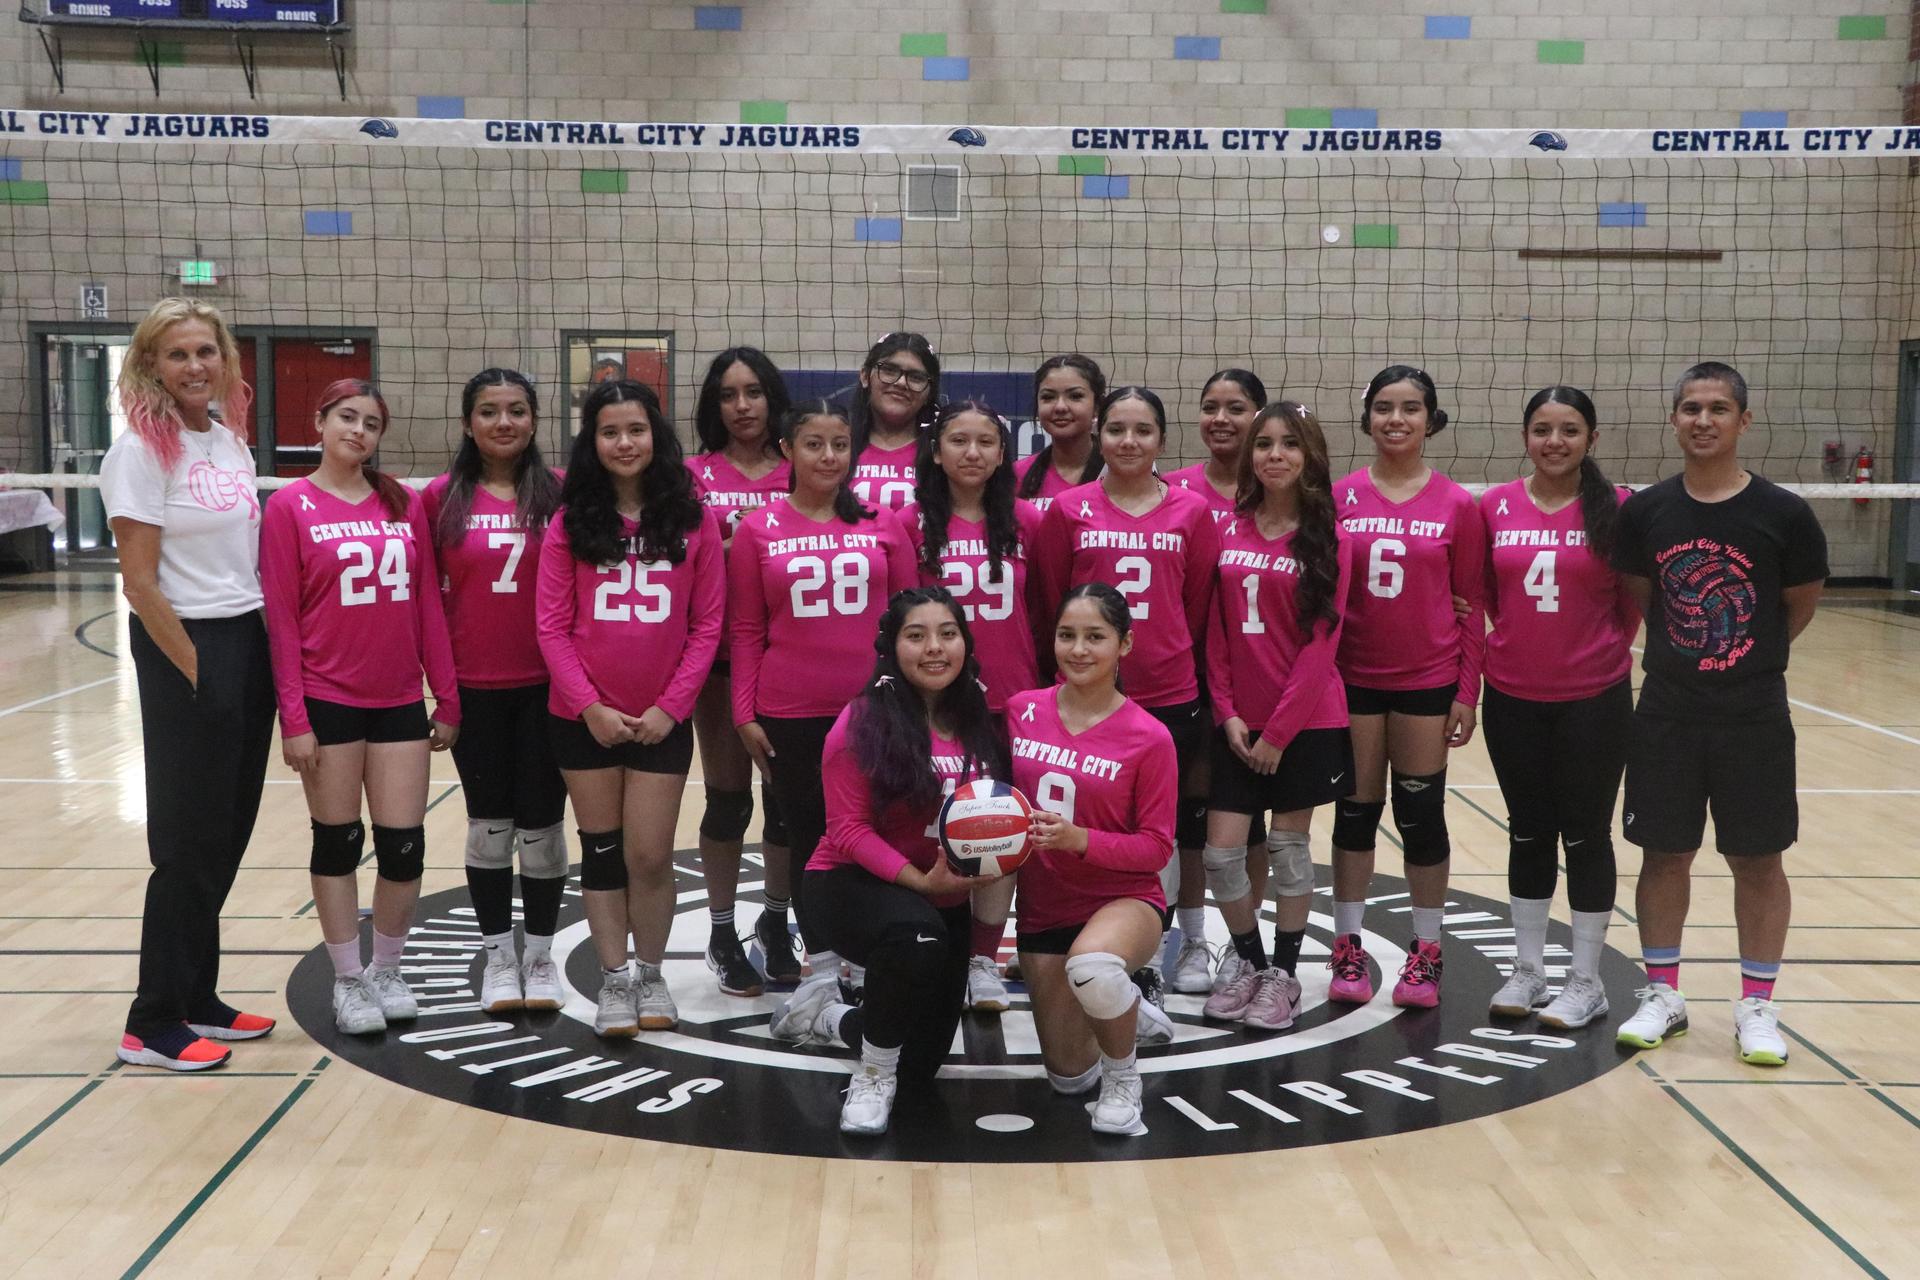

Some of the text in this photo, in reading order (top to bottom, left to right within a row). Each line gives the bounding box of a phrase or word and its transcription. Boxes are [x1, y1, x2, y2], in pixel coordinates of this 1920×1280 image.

[38, 112, 110, 136] CITY
[124, 115, 270, 138] JAGUARS
[485, 120, 861, 148] CENTRAL CITY JAGUARS
[1071, 128, 1443, 152] CENTRAL CITY JAGUARS
[1652, 130, 1790, 152] CENTRAL
[1802, 129, 1873, 151] CITY
[309, 520, 413, 544] CENTRAL CITY
[767, 533, 878, 557] CENTRAL CITY
[1080, 530, 1183, 553] CENTRAL CITY
[1342, 516, 1447, 539] CENTRAL CITY
[1656, 540, 1695, 564] Central
[1696, 537, 1722, 554] City
[336, 537, 411, 607] 24
[487, 532, 527, 593] 7
[786, 551, 870, 618] 28
[1114, 555, 1152, 621] 2
[1366, 537, 1407, 600] 6
[1522, 550, 1561, 613] 4
[593, 558, 673, 624] 25
[940, 560, 1015, 622] 29
[1241, 573, 1266, 634] 1
[1012, 736, 1123, 783] CENTRAL CITY
[1035, 771, 1077, 826] 9
